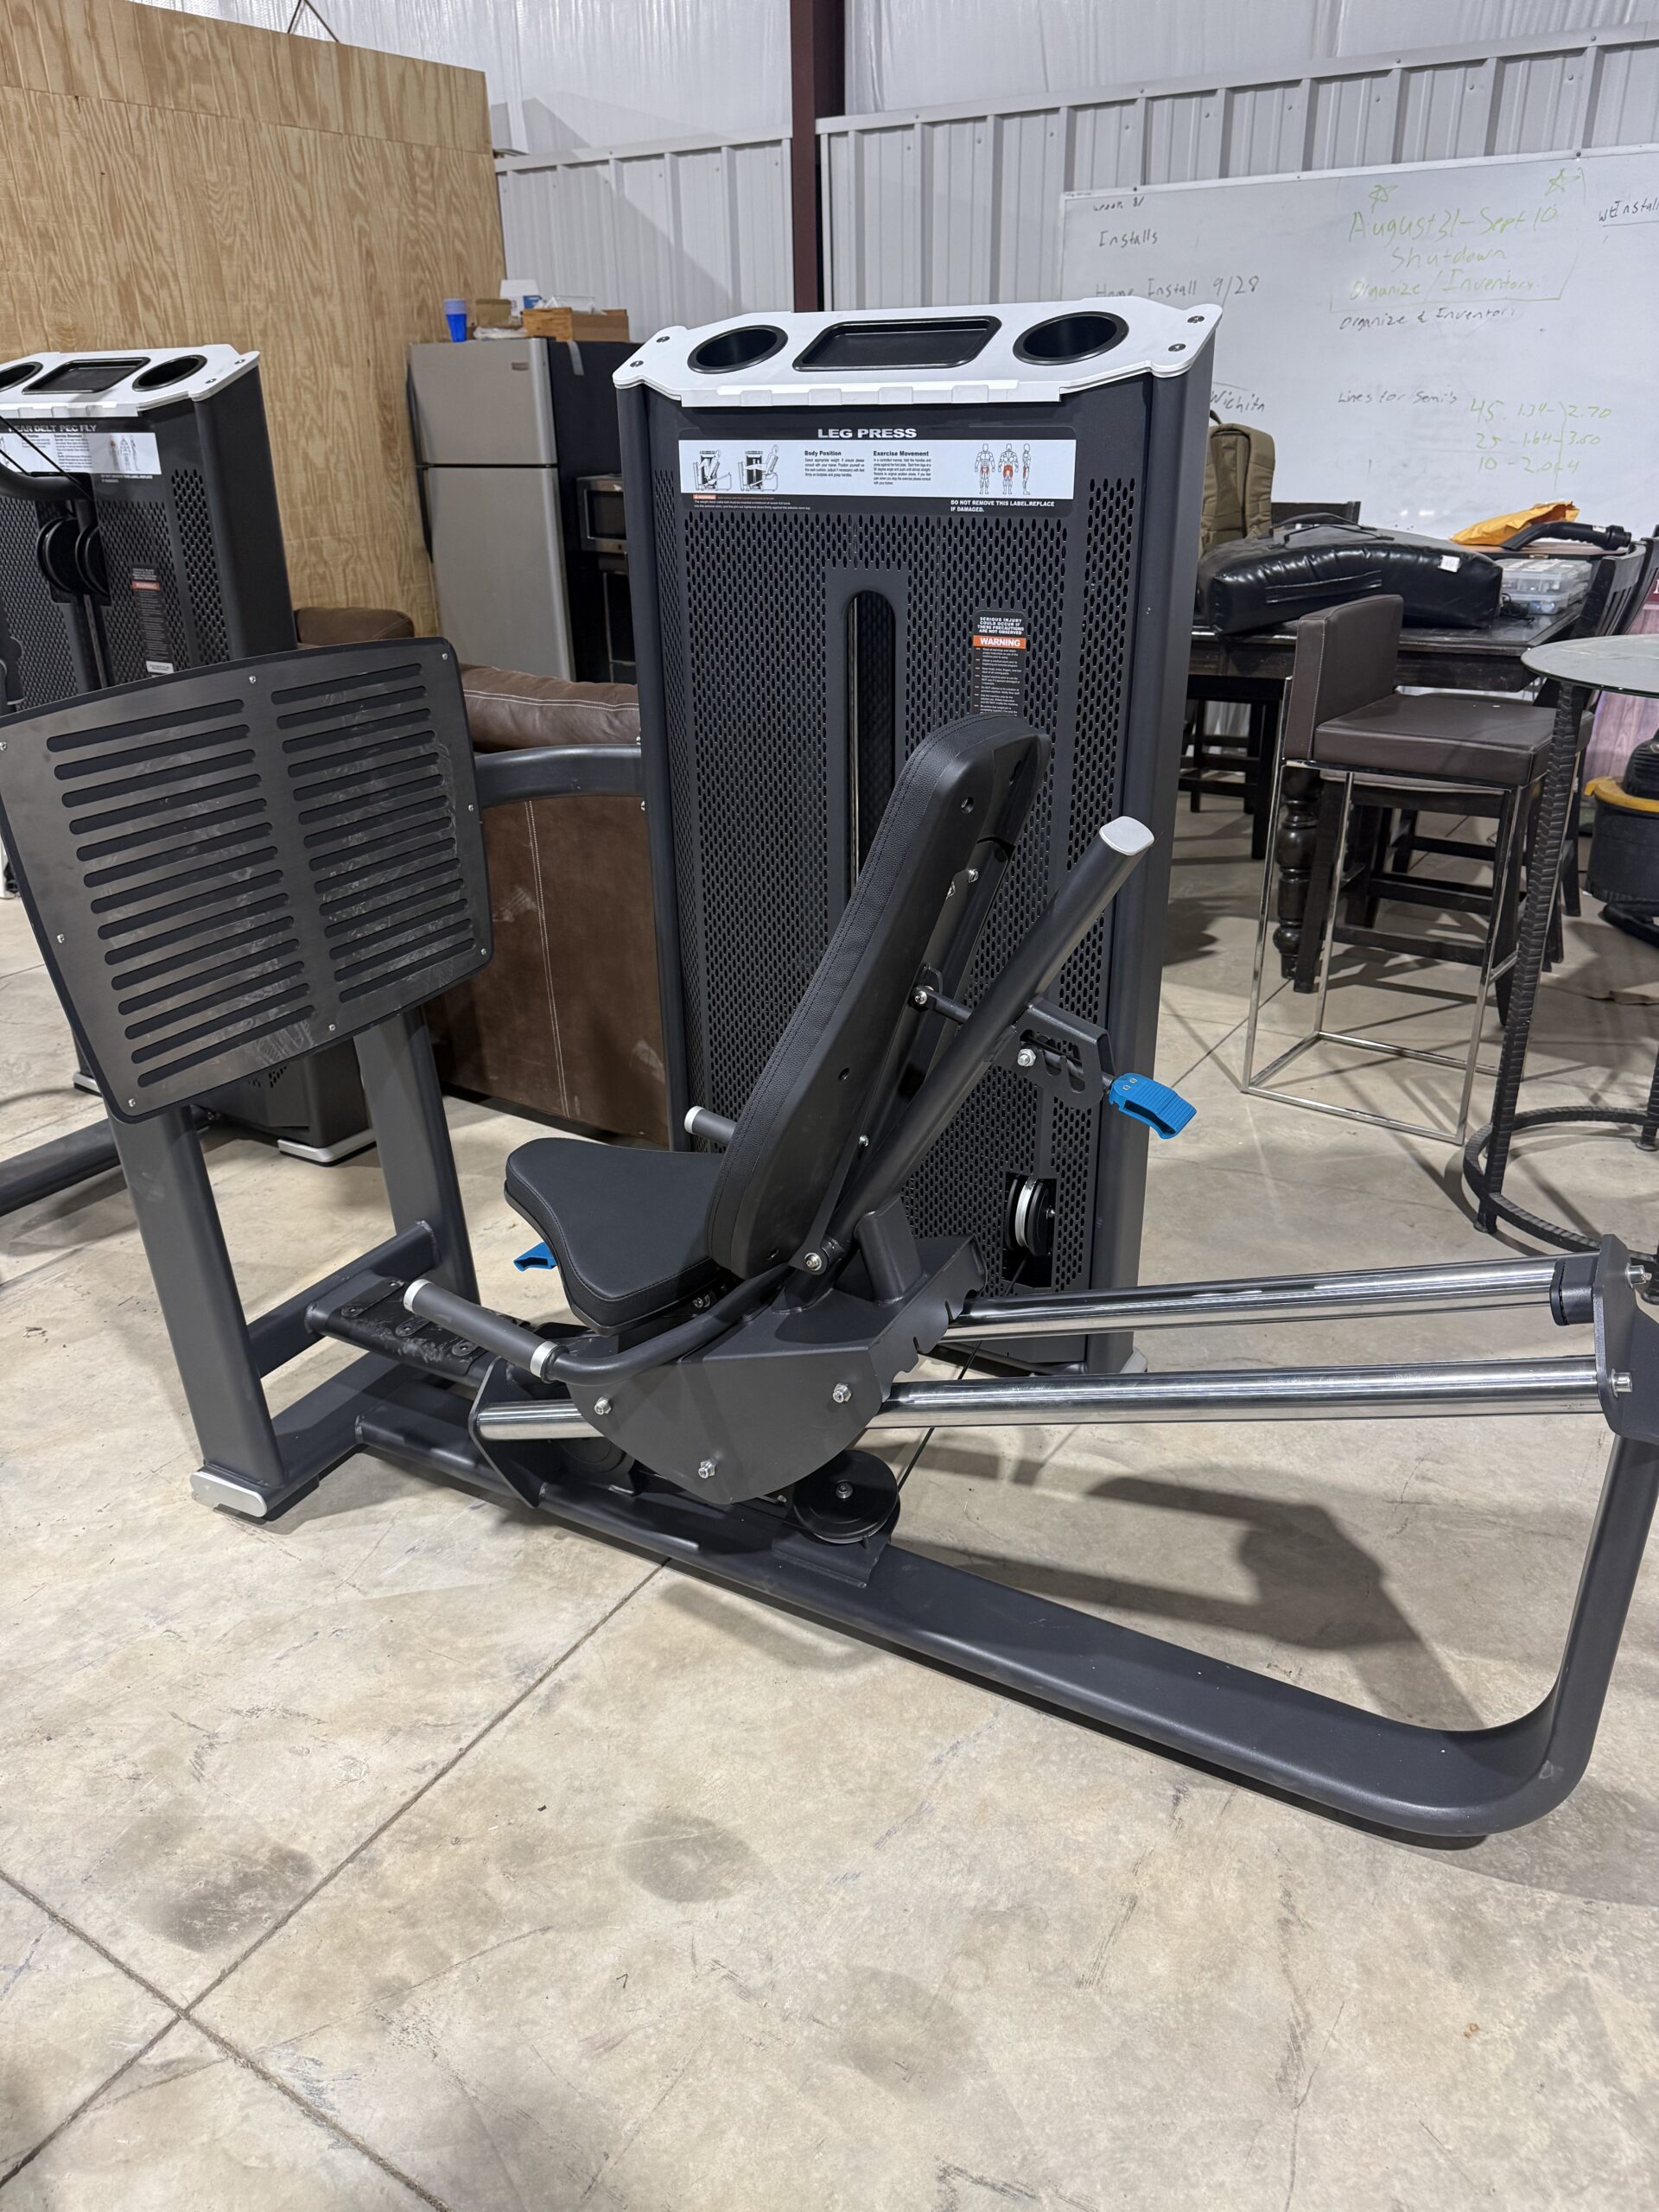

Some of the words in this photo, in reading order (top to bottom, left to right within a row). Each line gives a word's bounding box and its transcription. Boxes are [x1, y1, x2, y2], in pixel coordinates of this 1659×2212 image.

[1099, 228, 1159, 249] Installs
[1349, 211, 1435, 248] August
[1147, 277, 1198, 298] Install
[817, 429, 853, 439] LEG
[857, 428, 918, 439] PRESS
[980, 637, 1020, 647] WARNING
